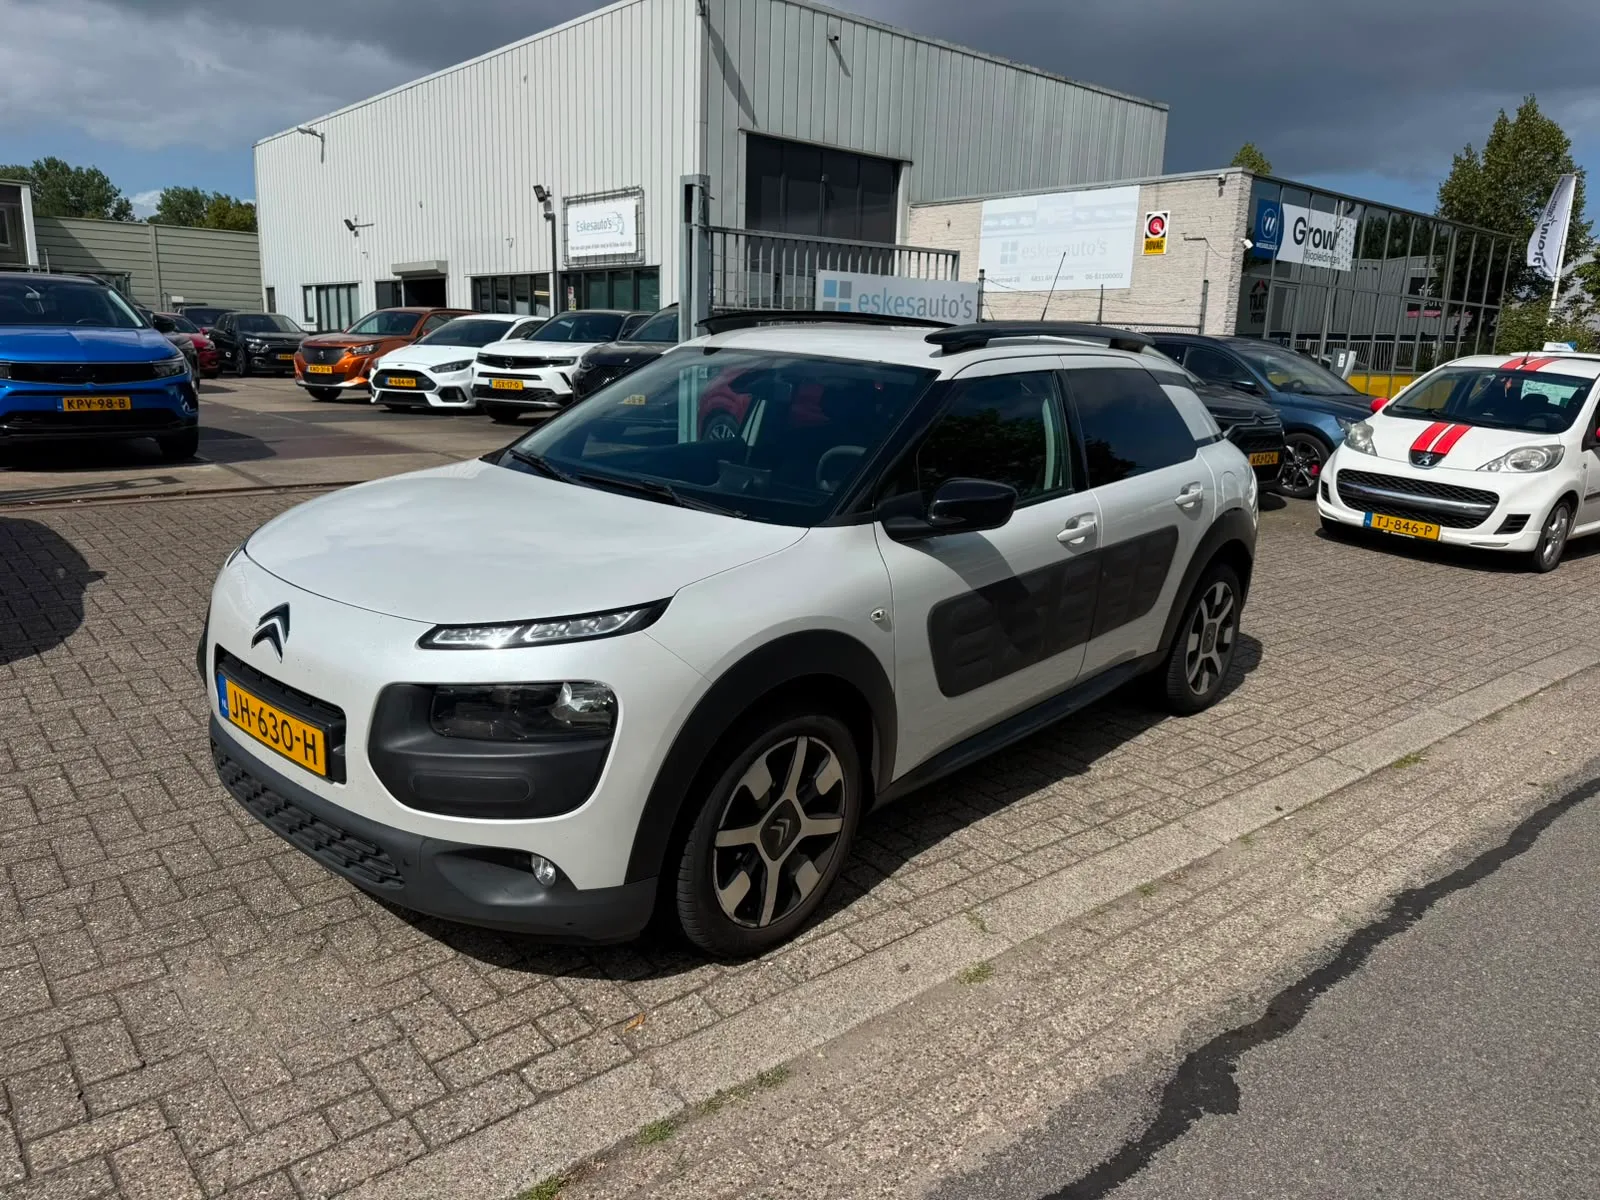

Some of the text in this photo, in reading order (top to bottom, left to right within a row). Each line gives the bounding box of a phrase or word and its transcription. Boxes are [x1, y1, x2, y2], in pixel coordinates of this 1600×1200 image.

[858, 287, 973, 319] eskesauto's
[67, 398, 126, 410] KPV-98-B
[1377, 515, 1433, 536] TJ-846-P
[232, 690, 318, 766] JH-630-H
